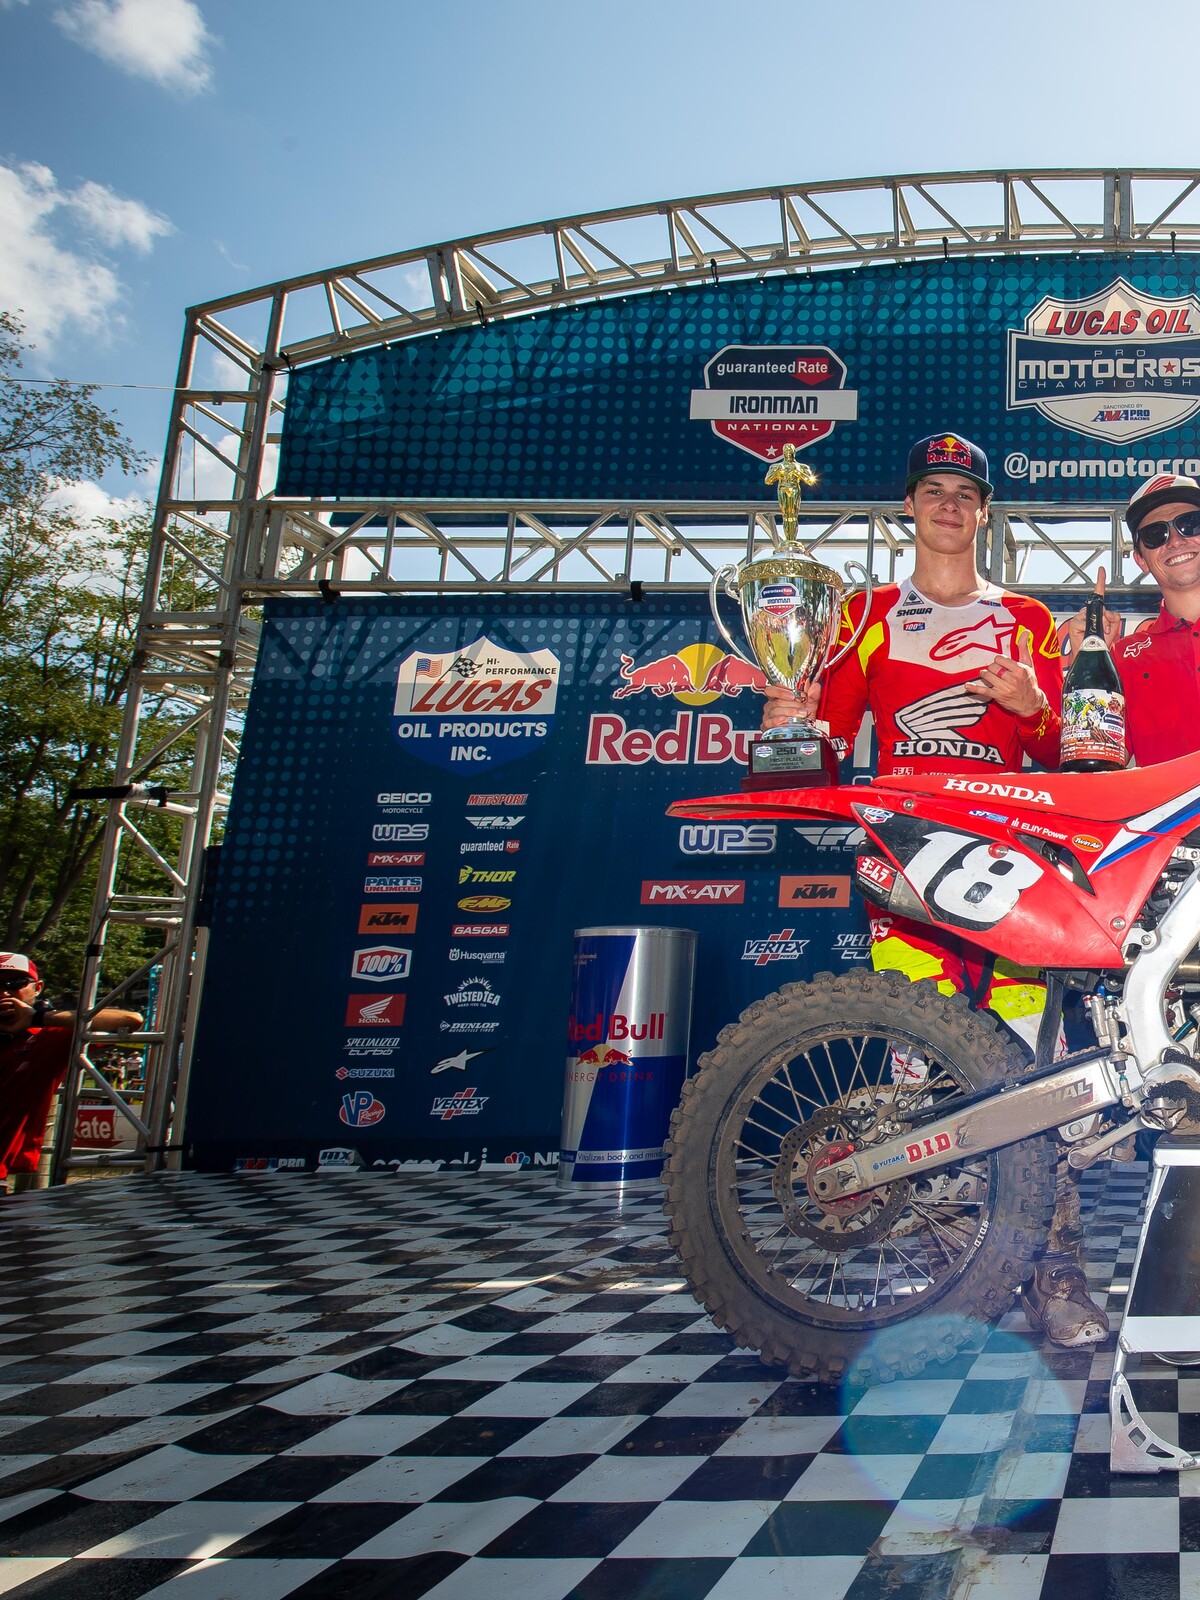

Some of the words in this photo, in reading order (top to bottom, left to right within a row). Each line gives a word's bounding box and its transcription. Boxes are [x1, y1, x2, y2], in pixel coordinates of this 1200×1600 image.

[1045, 310, 1141, 335] LUCAS
[1145, 309, 1194, 334] OIL
[1094, 349, 1146, 357] PRO
[717, 361, 796, 375] guaranteed
[798, 361, 828, 374] Rate
[729, 395, 818, 414] IRONMAN
[1090, 409, 1130, 422] AMA
[1130, 409, 1150, 417] PRO
[728, 423, 819, 431] NATIONAL
[927, 452, 949, 464] Red
[950, 452, 972, 468] Bull
[896, 607, 933, 617] SHOWA
[904, 623, 924, 631] 100%
[485, 667, 557, 675] PERFORMANCE
[411, 679, 552, 713] LUCAS
[398, 723, 432, 738] OIL
[439, 722, 548, 738] PRODUCTS
[585, 711, 693, 765] Red
[694, 713, 761, 765] Bu
[450, 746, 492, 761] INC.
[776, 747, 797, 755] 250
[893, 739, 1005, 766] HONDA
[376, 792, 432, 804] GEICO
[943, 778, 1055, 806] HONDA
[468, 815, 526, 826] FLY
[372, 824, 429, 841] WPS
[679, 824, 777, 855] WPS
[1042, 827, 1068, 841] Power
[460, 840, 504, 854] guaranteed
[506, 841, 520, 849] Rate
[365, 877, 422, 886] PARTS
[472, 870, 517, 882] THOR
[903, 831, 1045, 923] 18
[649, 884, 687, 899] MX
[694, 884, 741, 899] ATV
[792, 884, 837, 899] KTM
[458, 899, 512, 908] FMF
[367, 911, 410, 926] KTM
[453, 926, 508, 934] GASGAS
[745, 939, 810, 954] VERTEX
[460, 950, 505, 960] Husqvarna
[360, 955, 404, 973] 100%
[443, 990, 484, 1006] TWISTED
[482, 990, 501, 1006] TEA
[608, 1013, 664, 1041] Bull
[347, 1037, 400, 1047] SPECIALIZED
[348, 1048, 393, 1056] turbo
[349, 1068, 395, 1078] SUZUKI
[608, 1071, 654, 1082] DRINK
[342, 1091, 374, 1126] VP
[433, 1097, 489, 1110] VERTEX
[906, 1133, 951, 1162] D.I.D
[577, 1153, 605, 1161] Vitalizes
[607, 1152, 627, 1162] body
[629, 1152, 644, 1160] and
[879, 1153, 905, 1168] YUTAKA
